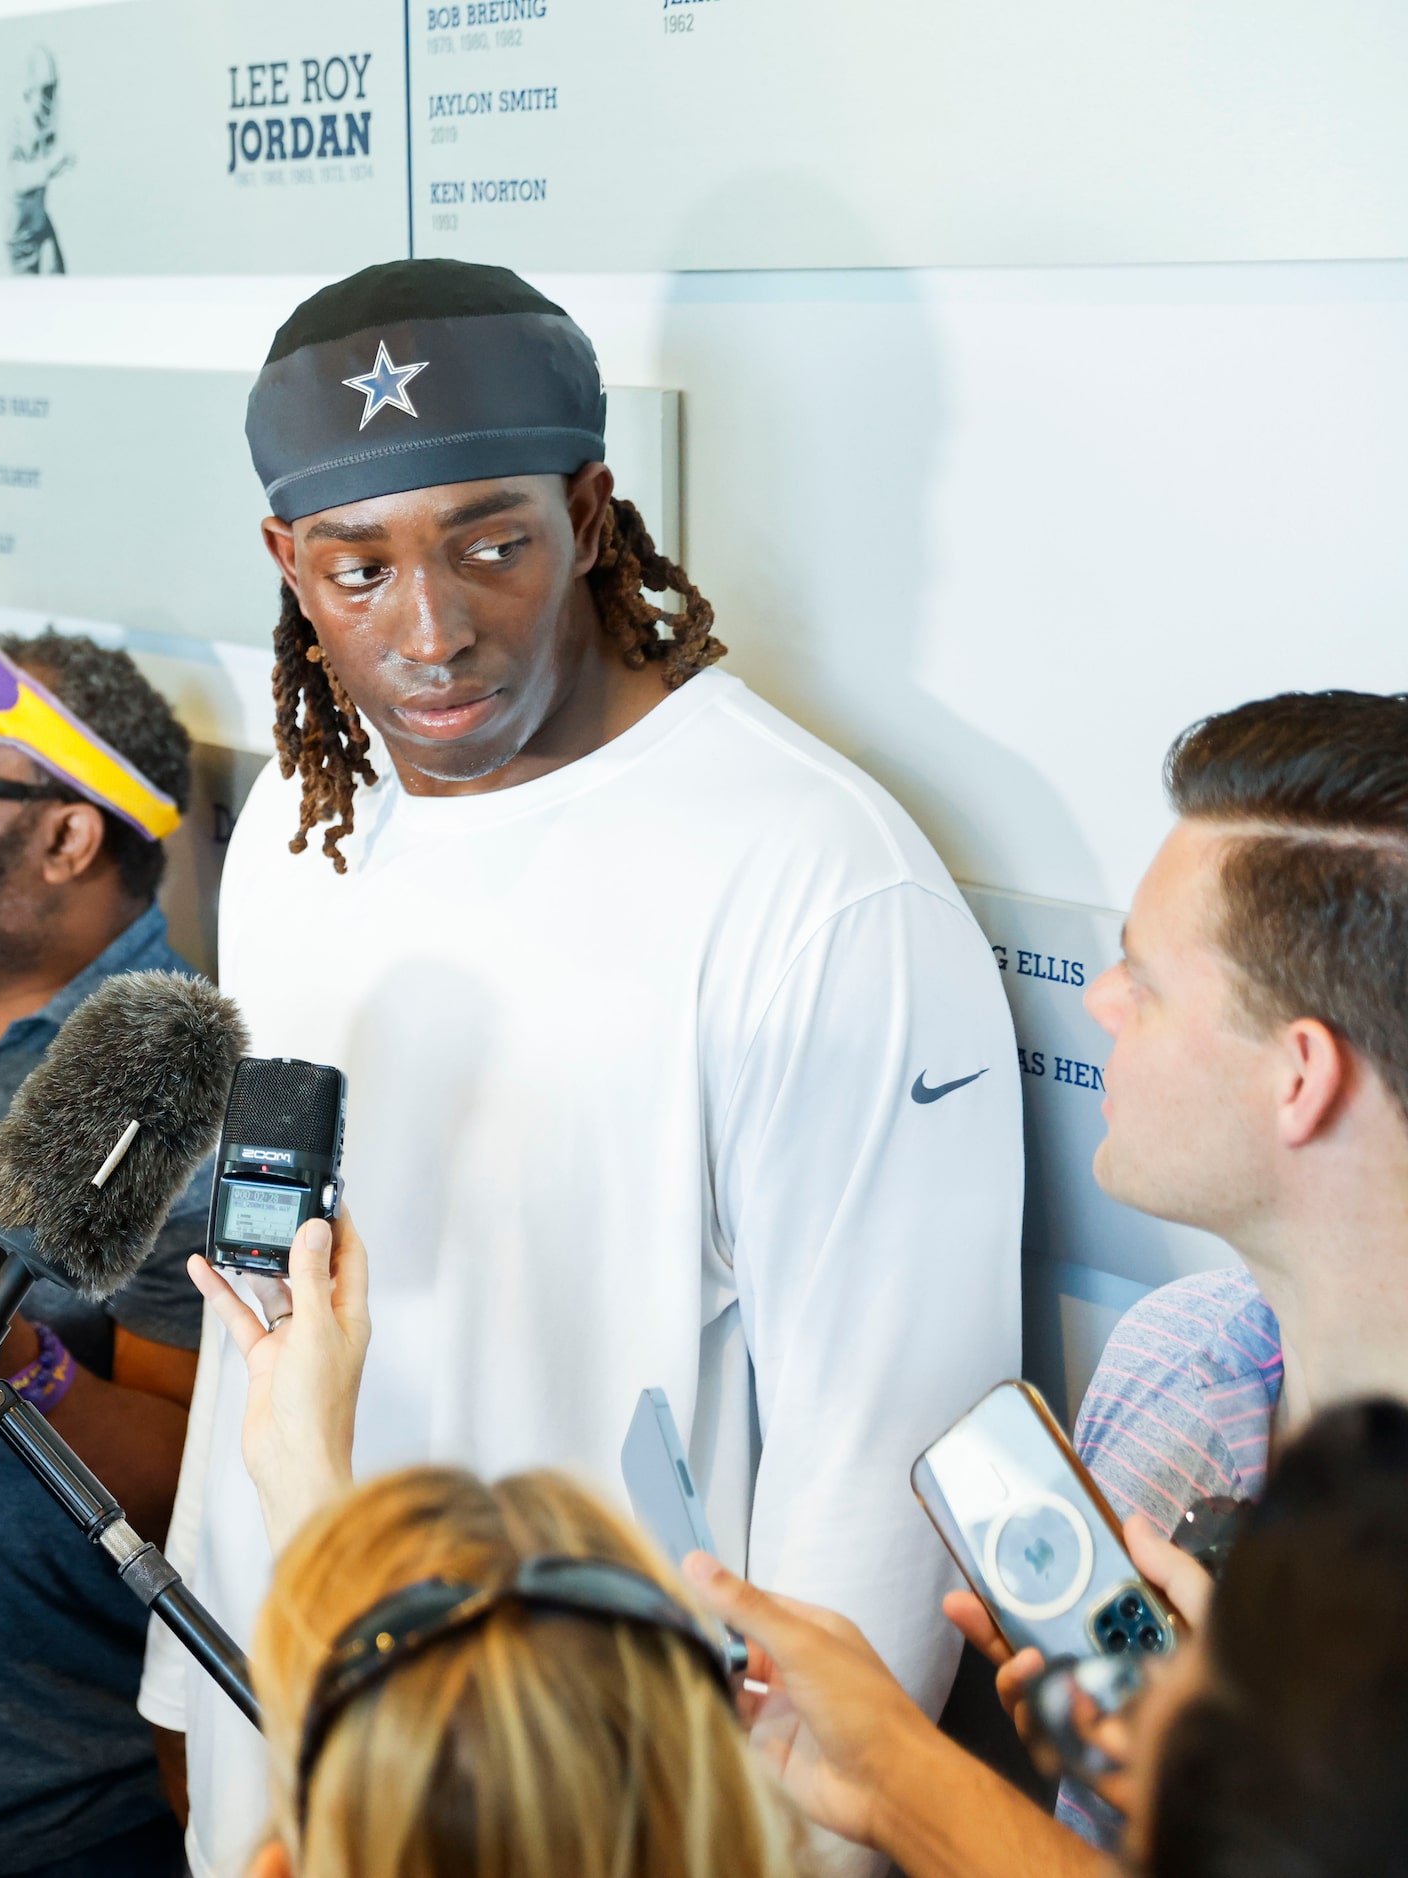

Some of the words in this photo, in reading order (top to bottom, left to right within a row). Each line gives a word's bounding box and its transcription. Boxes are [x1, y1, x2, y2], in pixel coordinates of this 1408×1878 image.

[428, 5, 460, 30] BOB
[466, 0, 547, 25] BREUNIG
[663, 13, 694, 34] 1962
[228, 62, 289, 109] LEE
[301, 53, 372, 103] ROY
[428, 91, 493, 120] JAYLON
[498, 86, 558, 113] SMITH
[228, 111, 372, 173] JORDAN
[430, 182, 465, 205] KEN
[471, 178, 548, 203] NORTON
[1017, 950, 1085, 987] ELLIS
[241, 1148, 291, 1164] ZOOM
